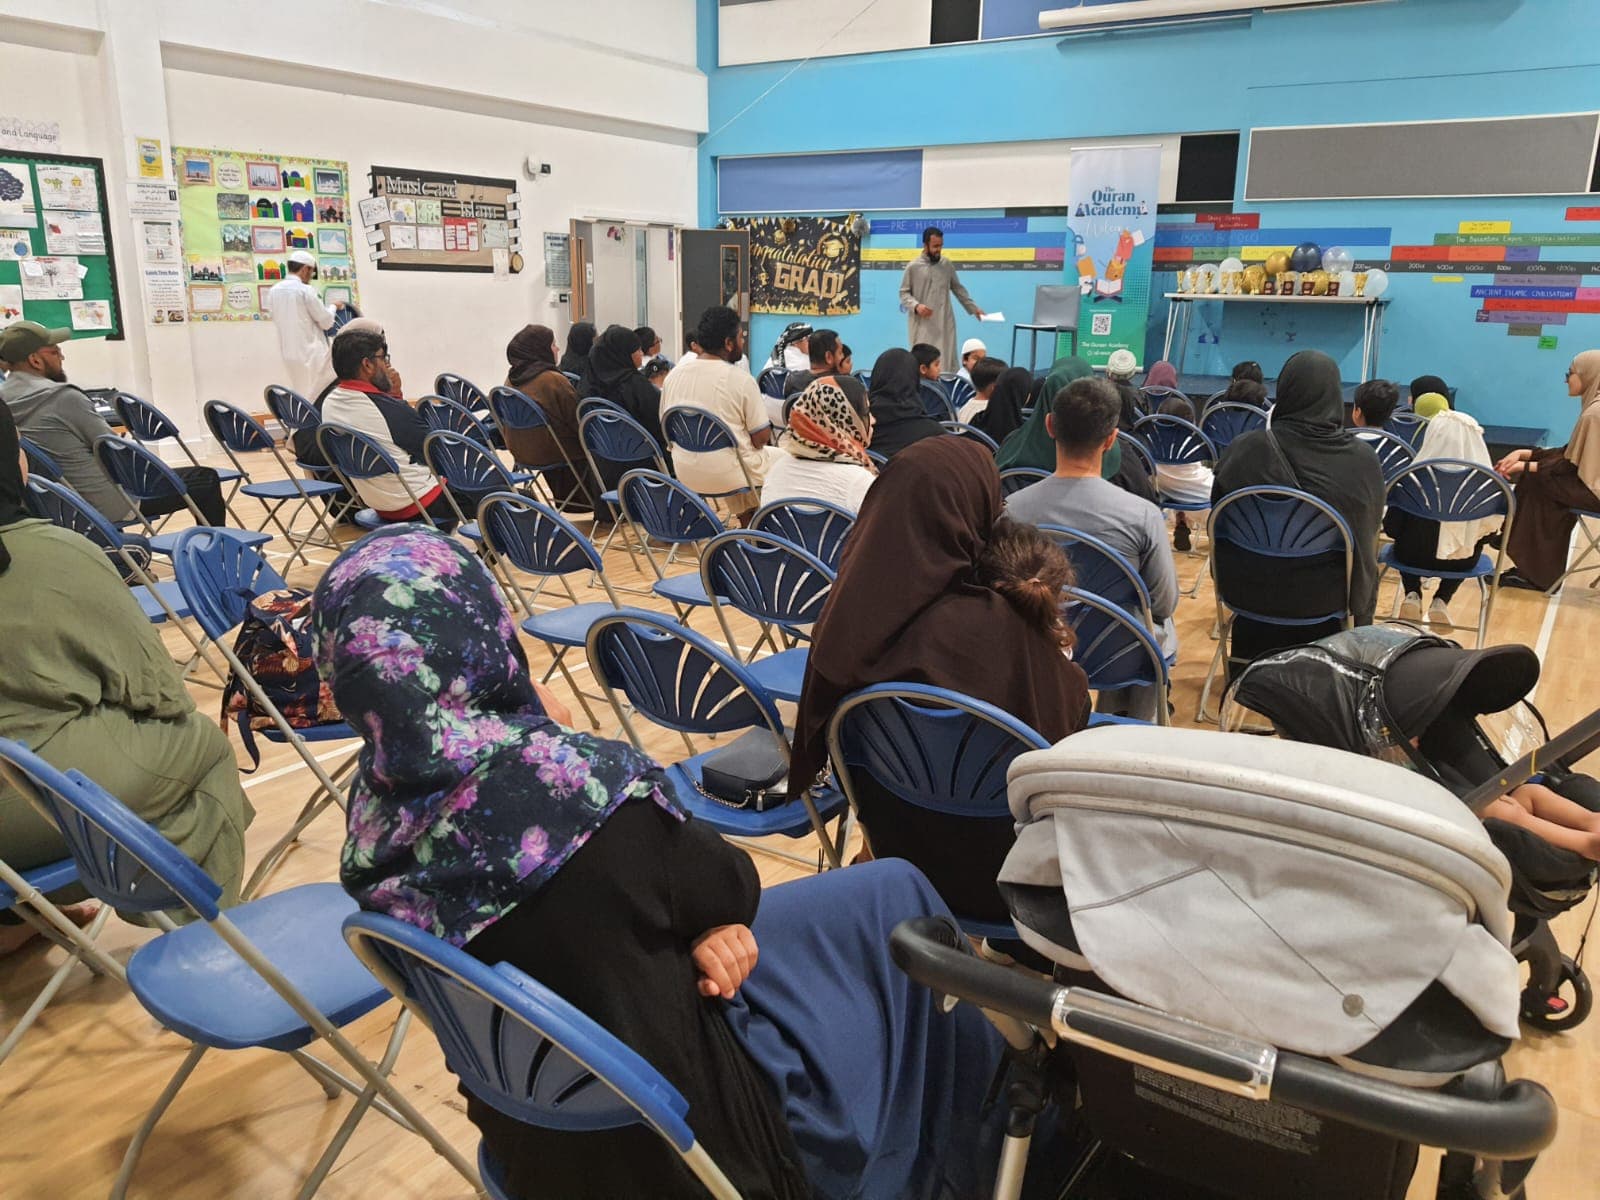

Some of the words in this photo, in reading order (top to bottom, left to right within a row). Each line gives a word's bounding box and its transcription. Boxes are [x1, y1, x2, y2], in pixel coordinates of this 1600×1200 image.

[18, 128, 57, 143] Language
[386, 175, 428, 197] Music
[1092, 189, 1135, 206] Quran
[460, 199, 497, 220] Islam
[1075, 202, 1148, 219] Academy
[1384, 262, 1391, 271] 0
[774, 262, 845, 299] GRAD!
